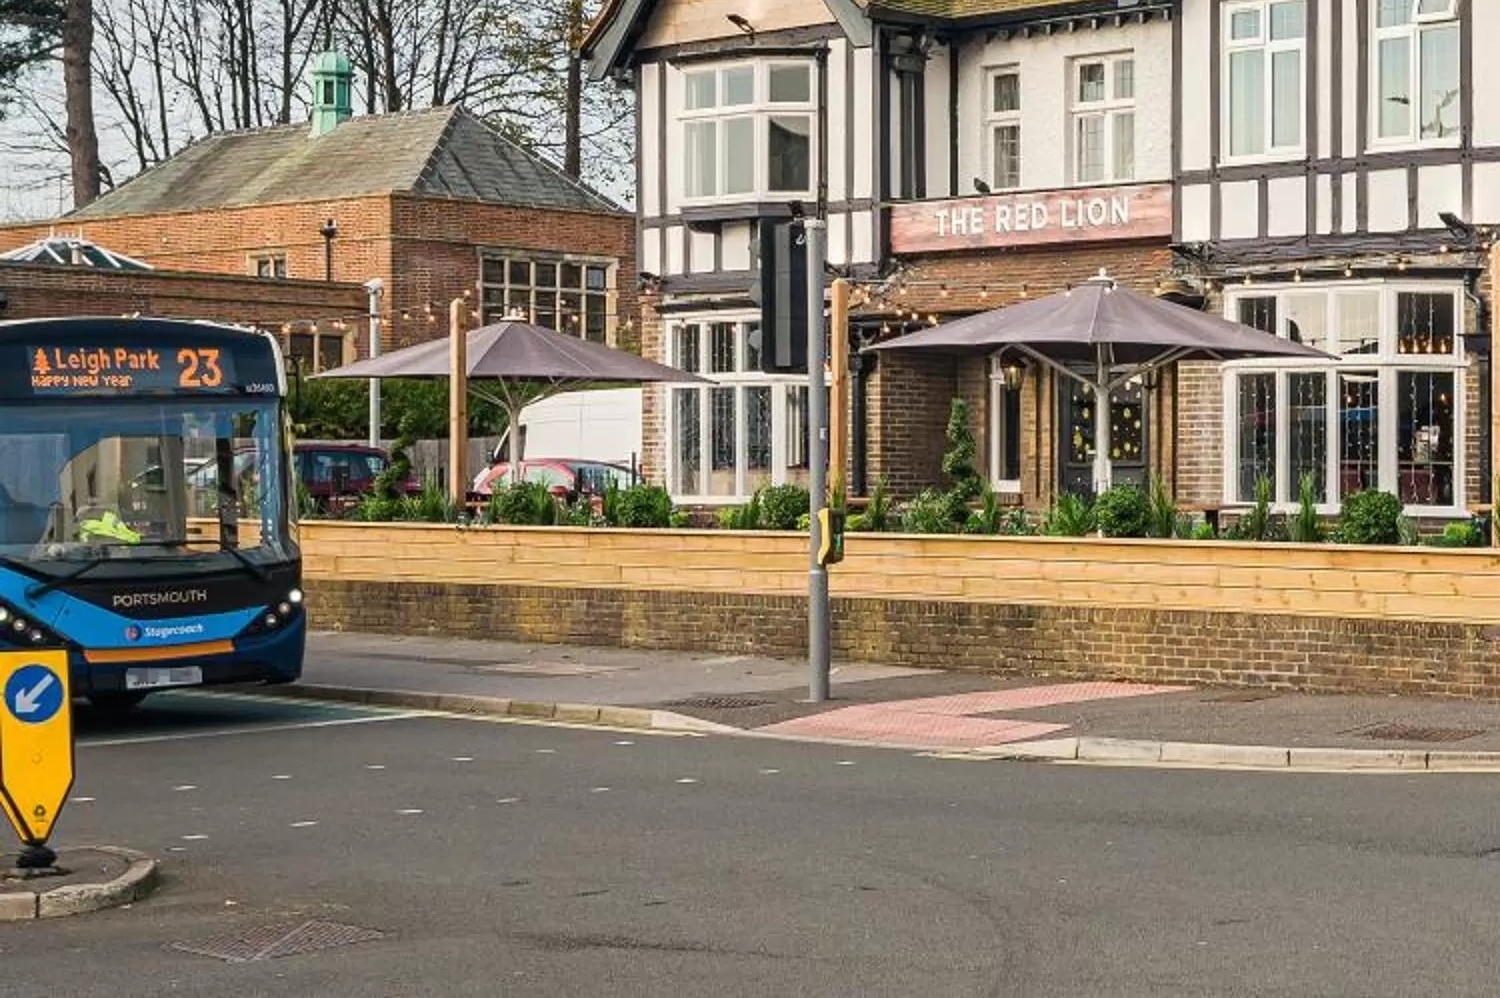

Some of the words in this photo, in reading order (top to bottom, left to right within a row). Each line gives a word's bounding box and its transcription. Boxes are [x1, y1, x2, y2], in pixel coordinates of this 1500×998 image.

[934, 206, 985, 237] THE
[994, 201, 1049, 234] RED
[1058, 195, 1131, 228] LION
[54, 348, 111, 375] Leigh
[114, 347, 160, 370] Park
[176, 348, 223, 387] 23
[113, 589, 208, 608] PORTSMOUTH
[144, 624, 205, 639] Stagecoach
